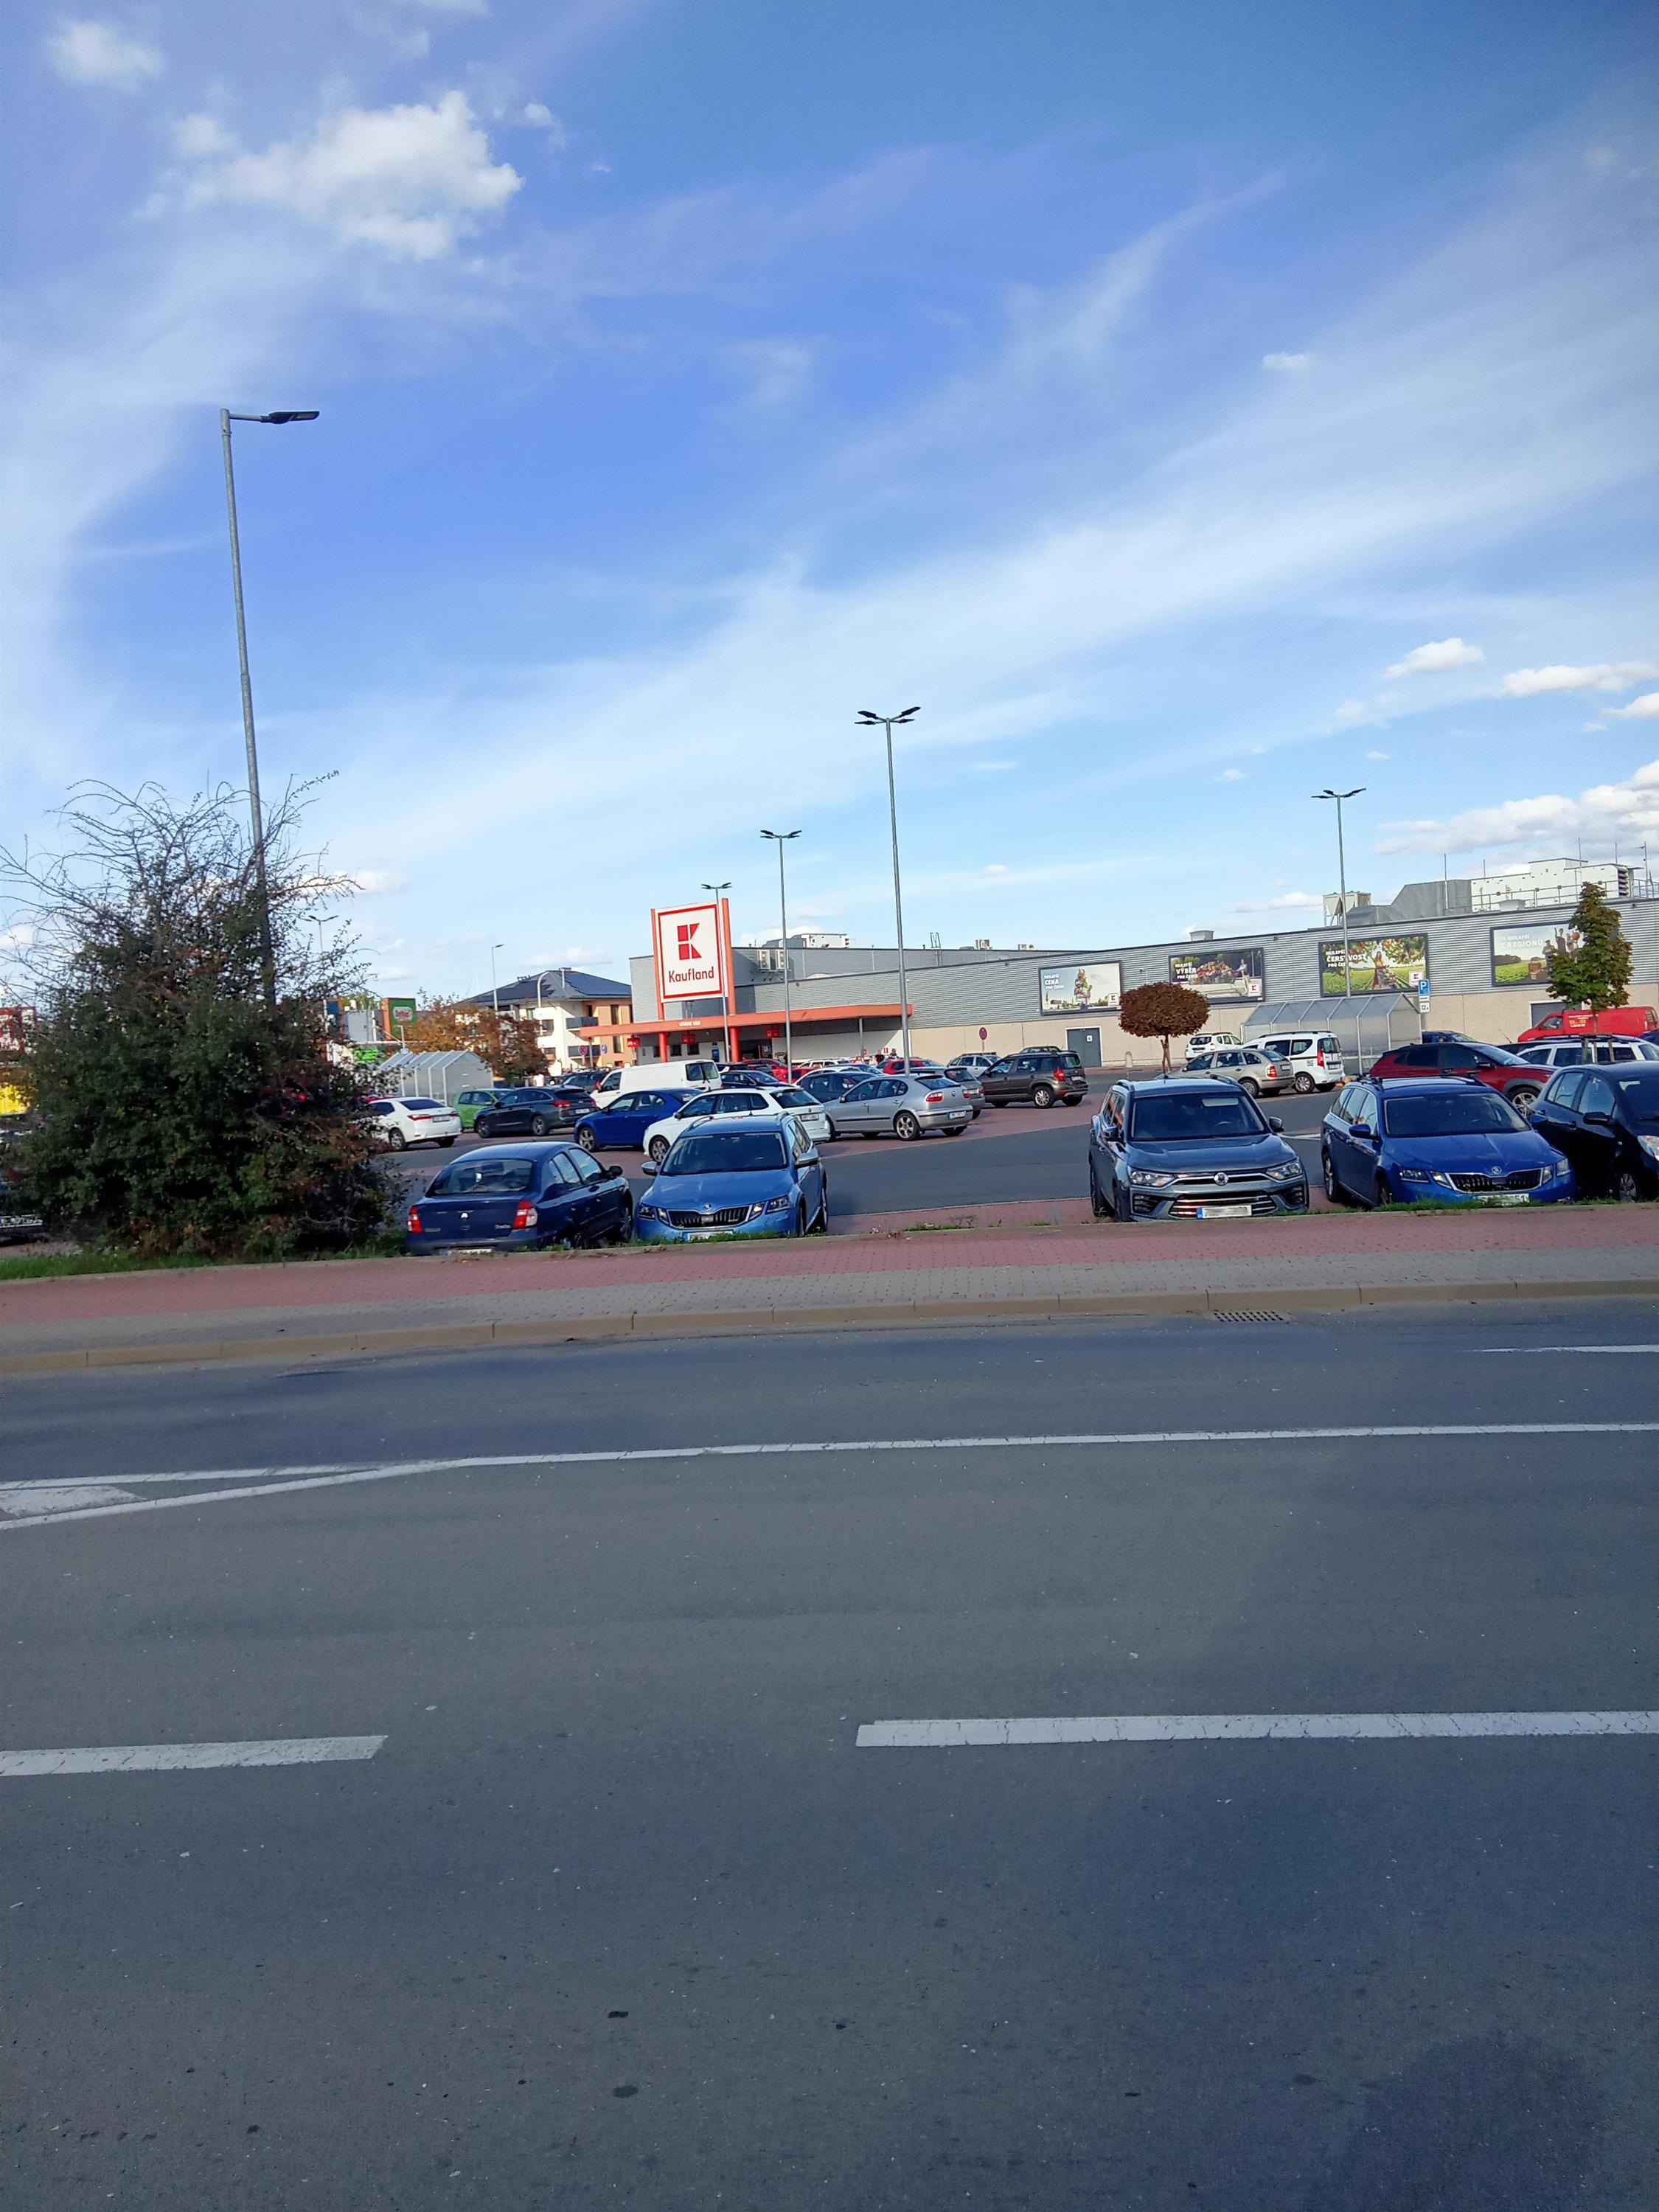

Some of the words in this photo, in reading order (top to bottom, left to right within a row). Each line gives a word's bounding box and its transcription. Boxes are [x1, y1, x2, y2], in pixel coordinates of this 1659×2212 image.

[677, 922, 702, 960] K
[669, 966, 714, 983] Kaufland
[1420, 981, 1427, 990] P
